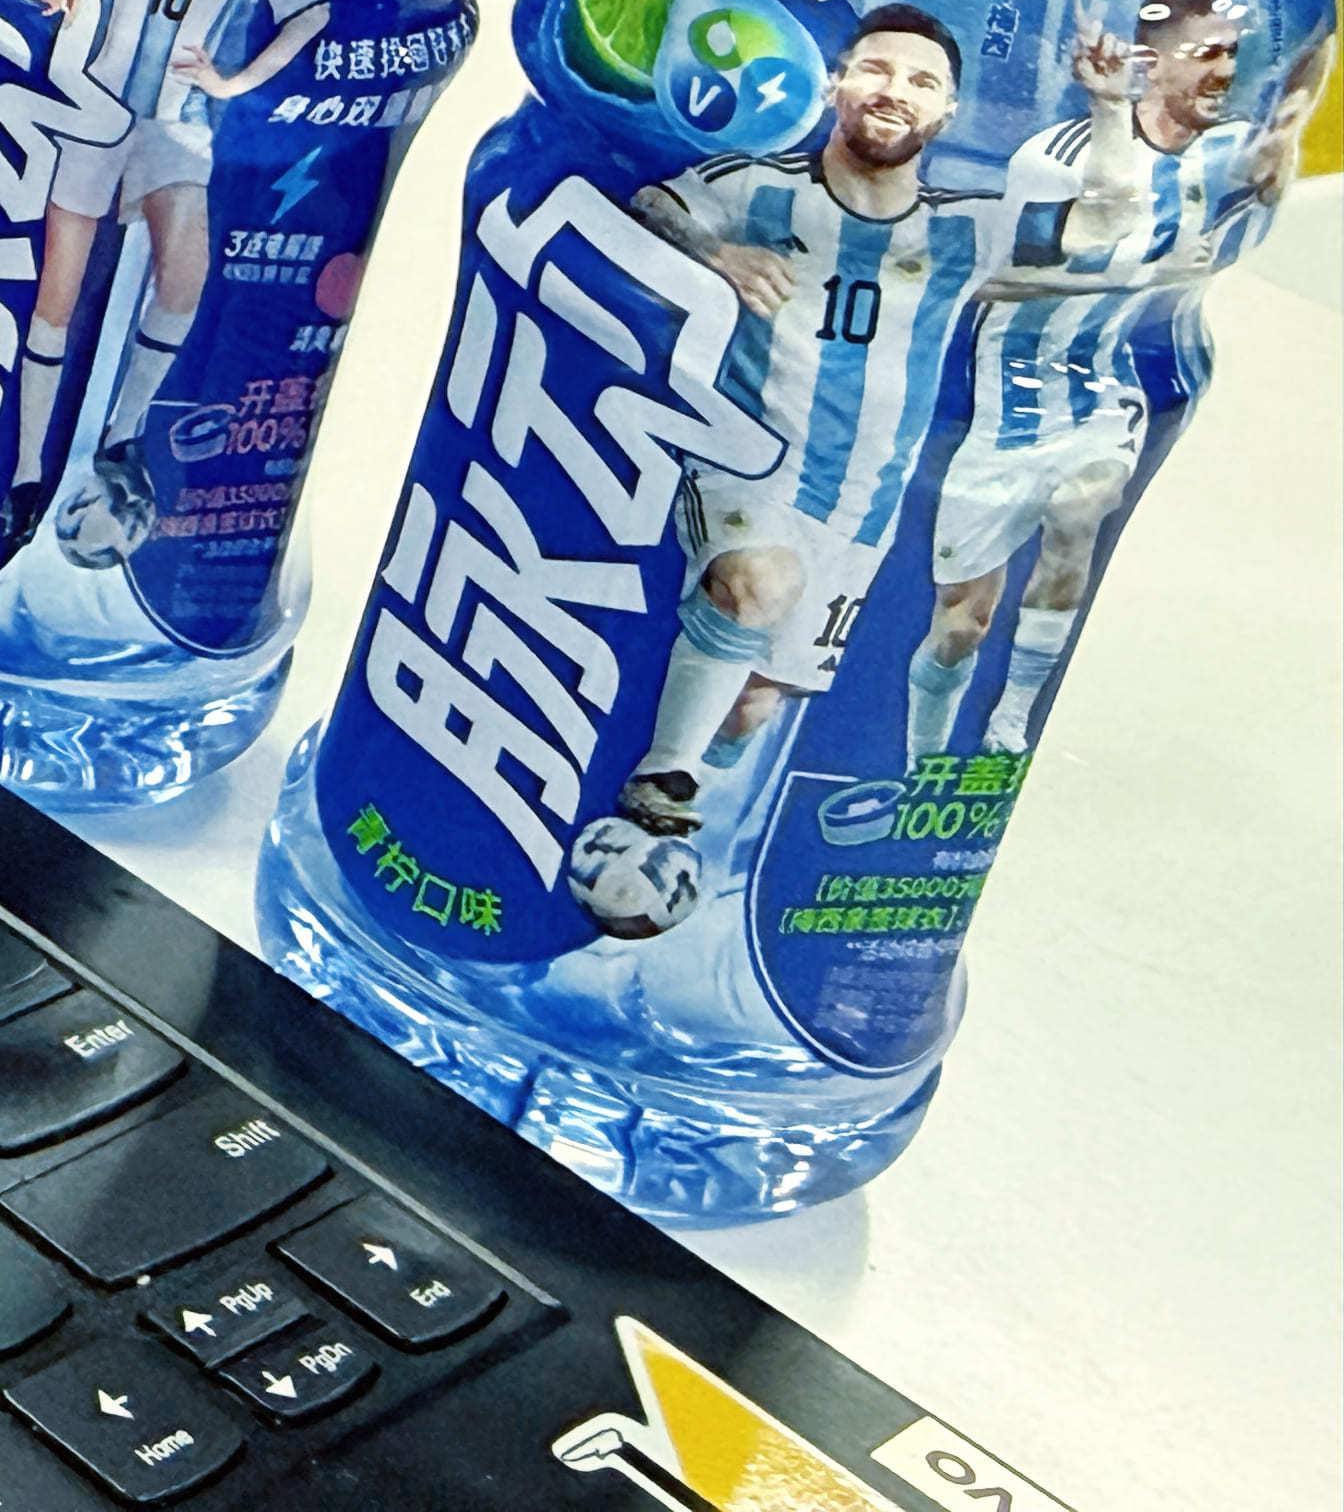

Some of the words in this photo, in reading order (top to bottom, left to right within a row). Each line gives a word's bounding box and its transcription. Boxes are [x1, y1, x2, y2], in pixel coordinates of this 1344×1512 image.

[815, 277, 882, 345] 10
[367, 175, 787, 892] 脉动
[815, 597, 864, 647] 10
[893, 802, 1004, 839] 100%
[347, 803, 502, 936] 青柠口味
[63, 1018, 136, 1059] Enter
[214, 1119, 281, 1158] Shift
[219, 1283, 274, 1315] PgUp
[409, 1280, 452, 1308] End
[298, 1342, 353, 1375] PgDn
[134, 1429, 195, 1467] Home
